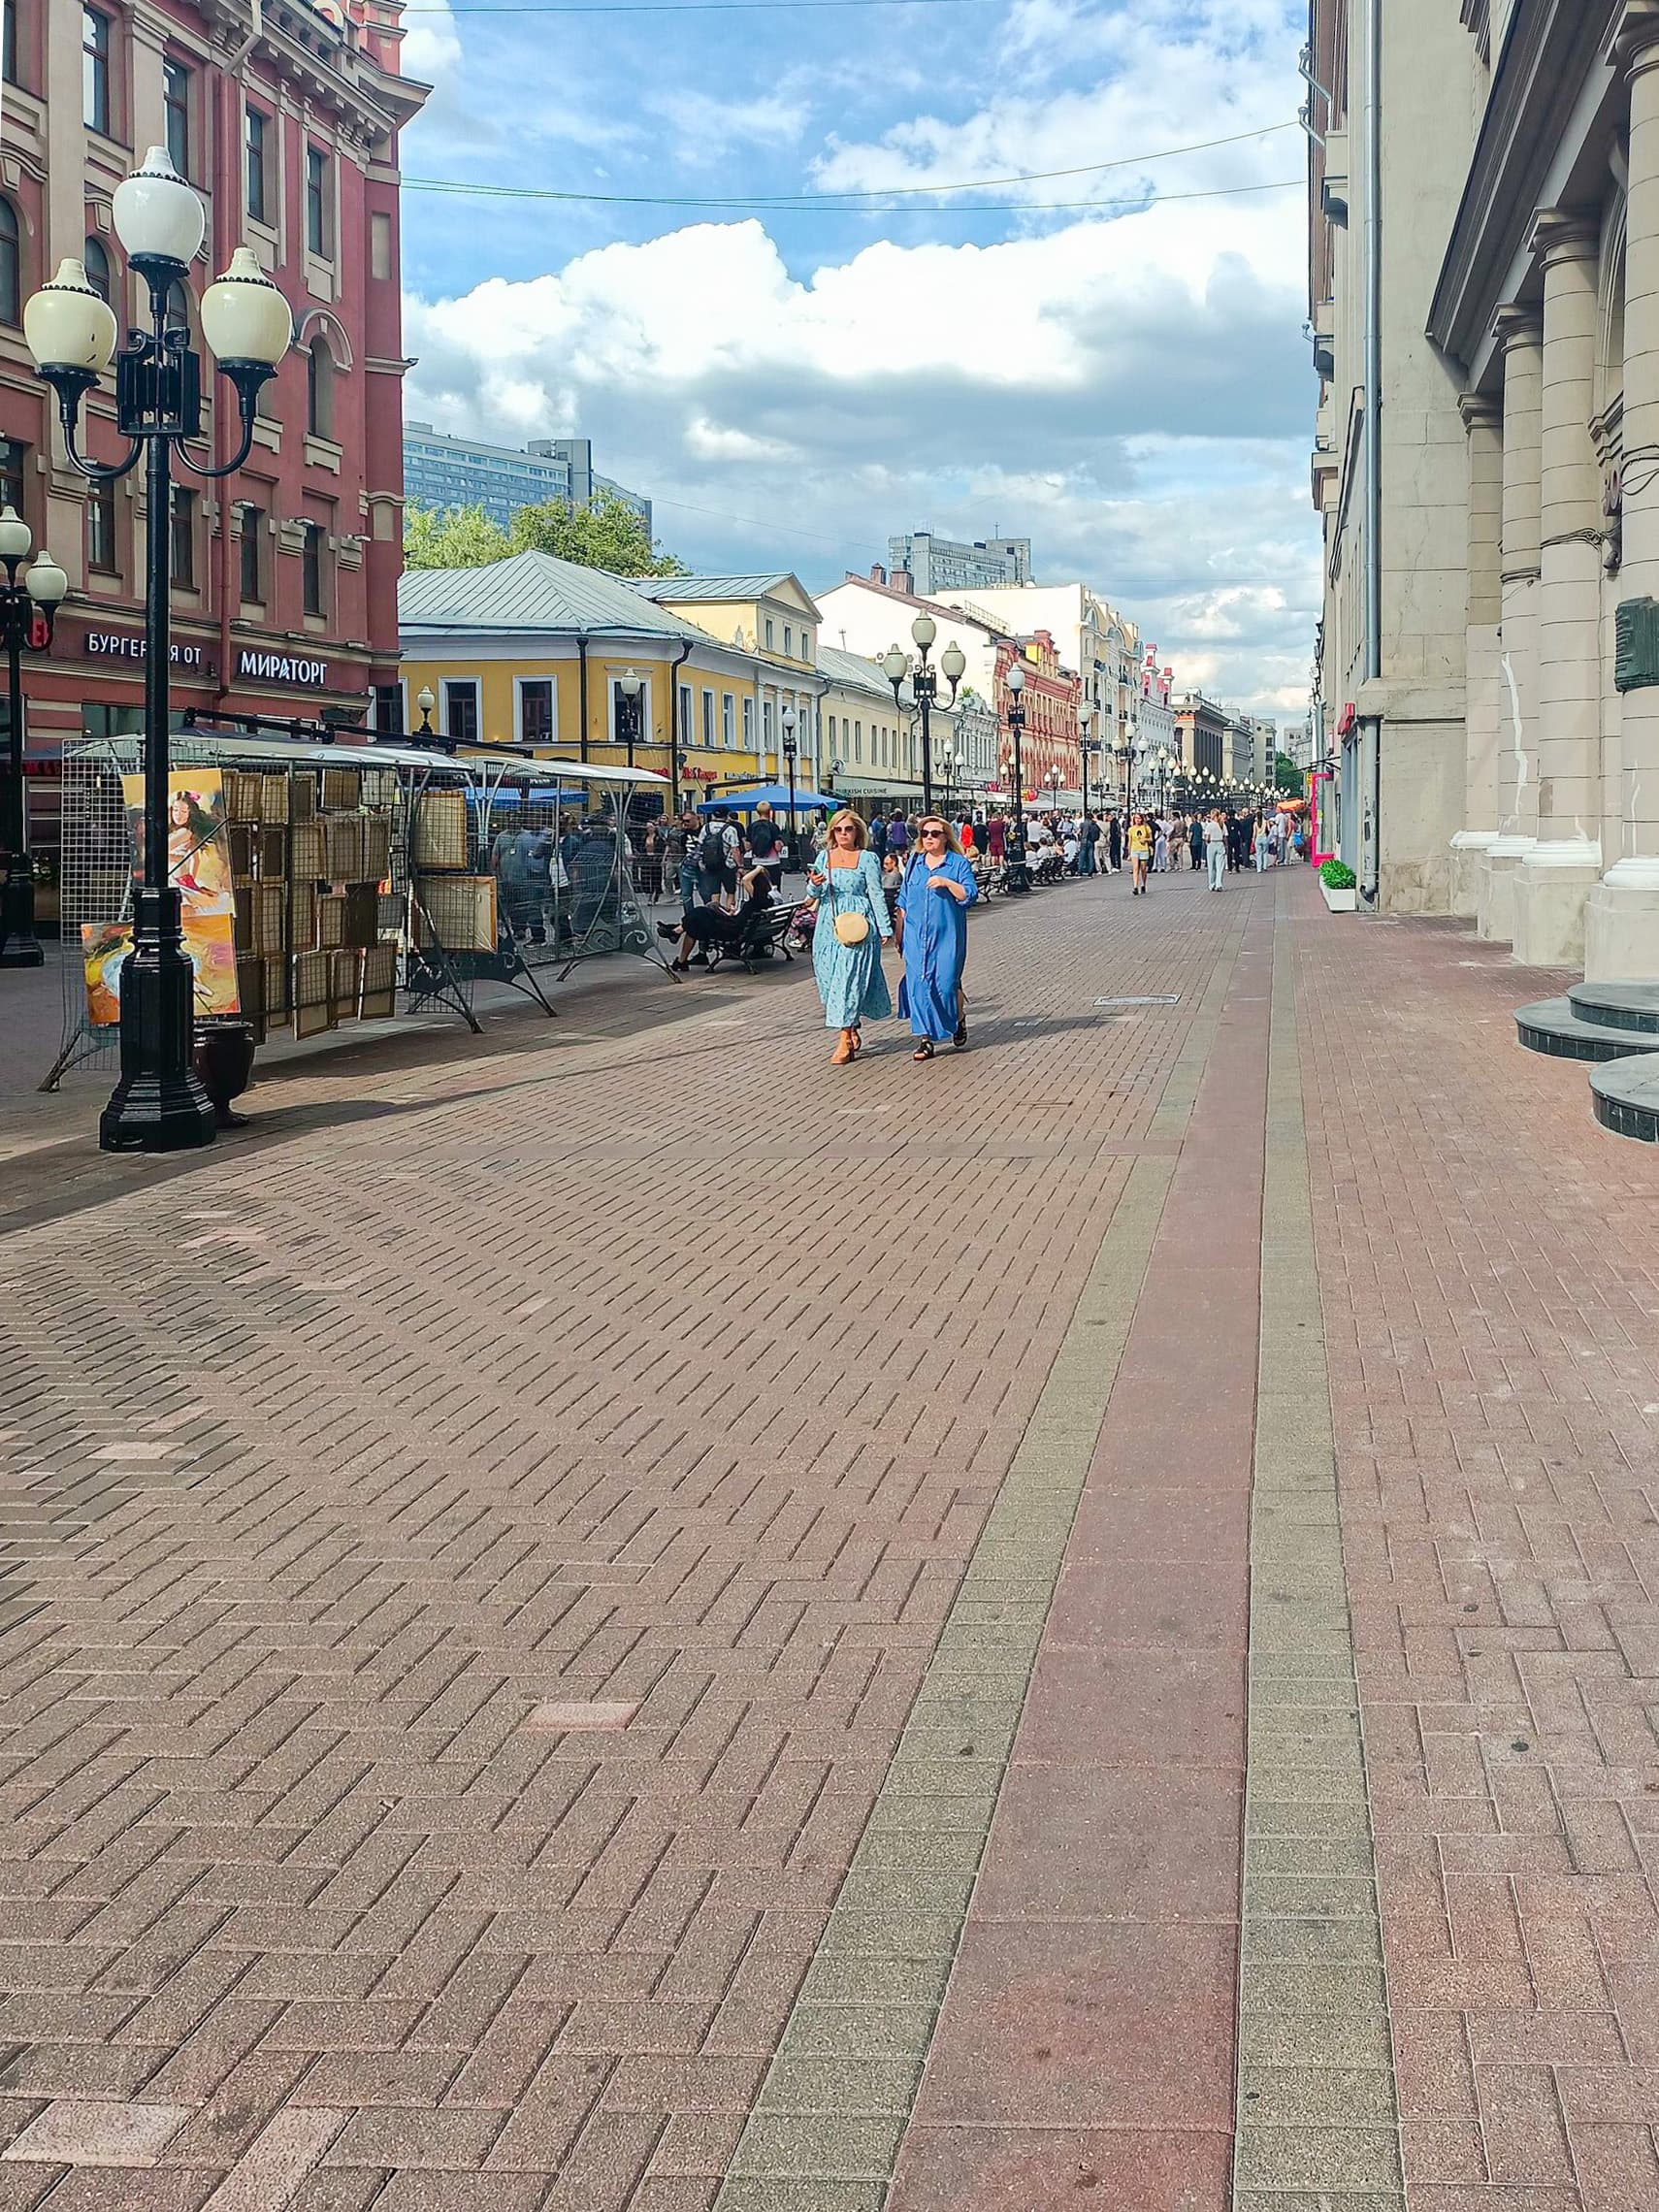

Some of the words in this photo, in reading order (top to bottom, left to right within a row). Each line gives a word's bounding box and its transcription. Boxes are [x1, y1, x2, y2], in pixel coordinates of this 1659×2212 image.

[89, 633, 179, 662] БУРГЕРЯ
[184, 646, 202, 665] ОТ
[241, 650, 328, 684] МИРАТОРГ
